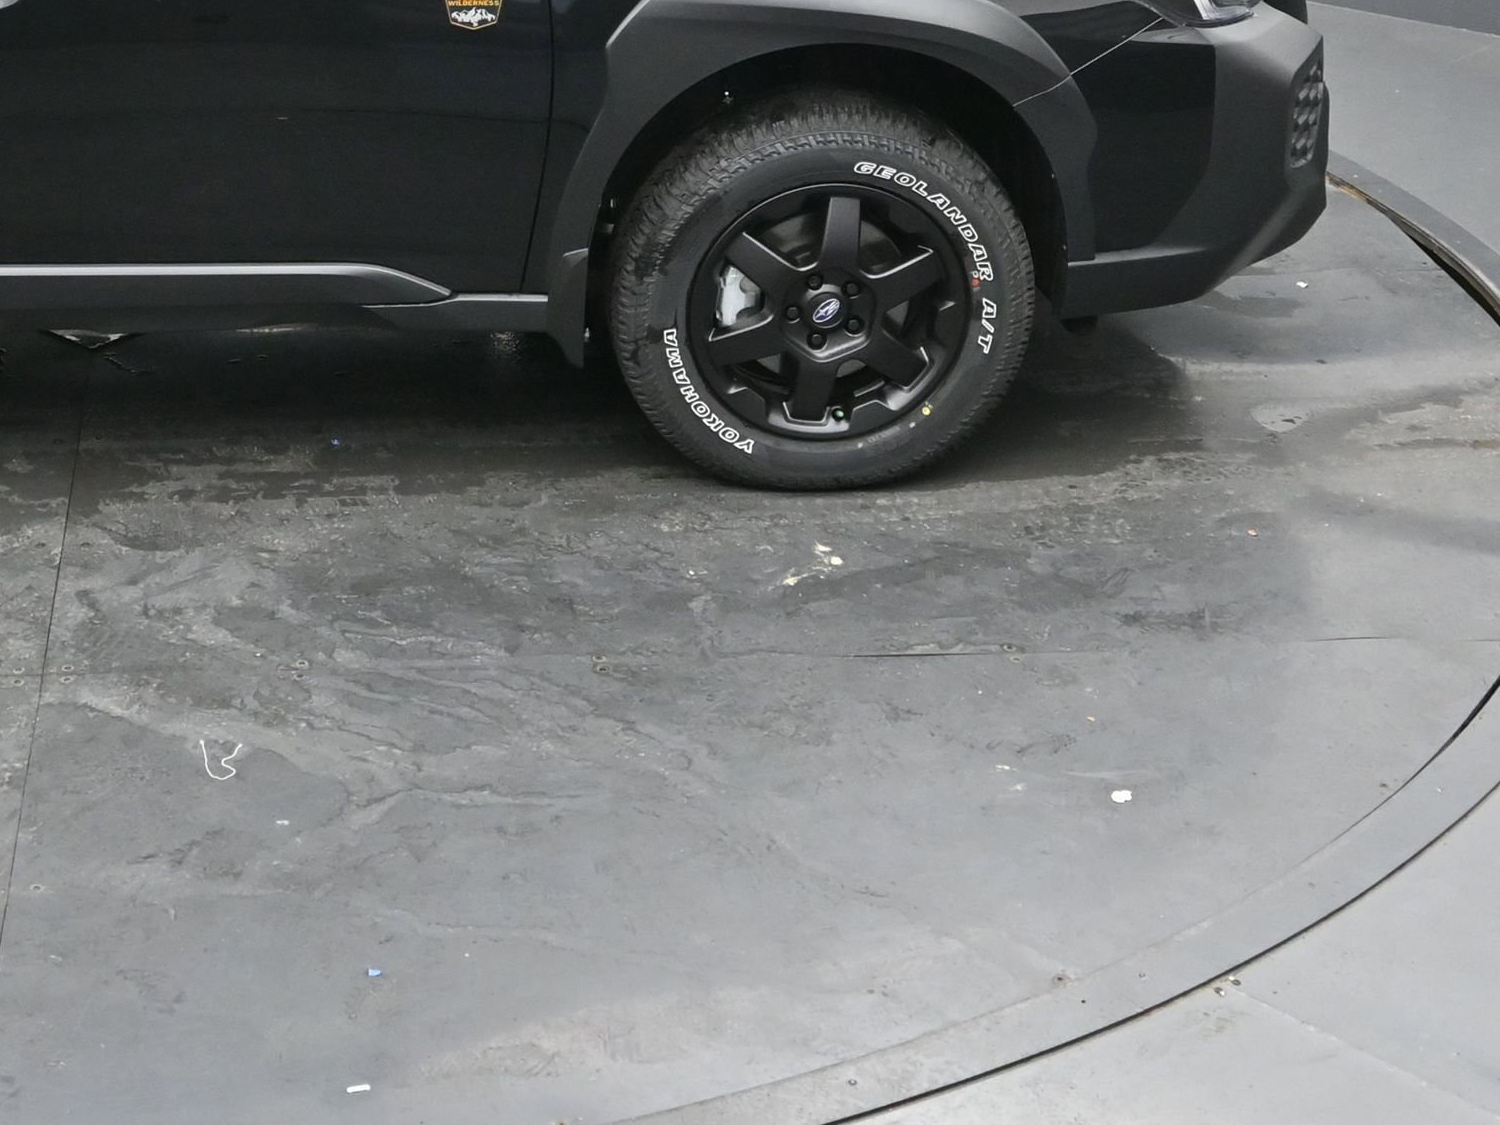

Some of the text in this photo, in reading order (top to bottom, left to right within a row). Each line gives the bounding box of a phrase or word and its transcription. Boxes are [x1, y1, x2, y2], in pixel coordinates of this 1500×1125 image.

[853, 161, 998, 354] GEOLANDAR A/T
[663, 328, 755, 454] YOKOHAMA
